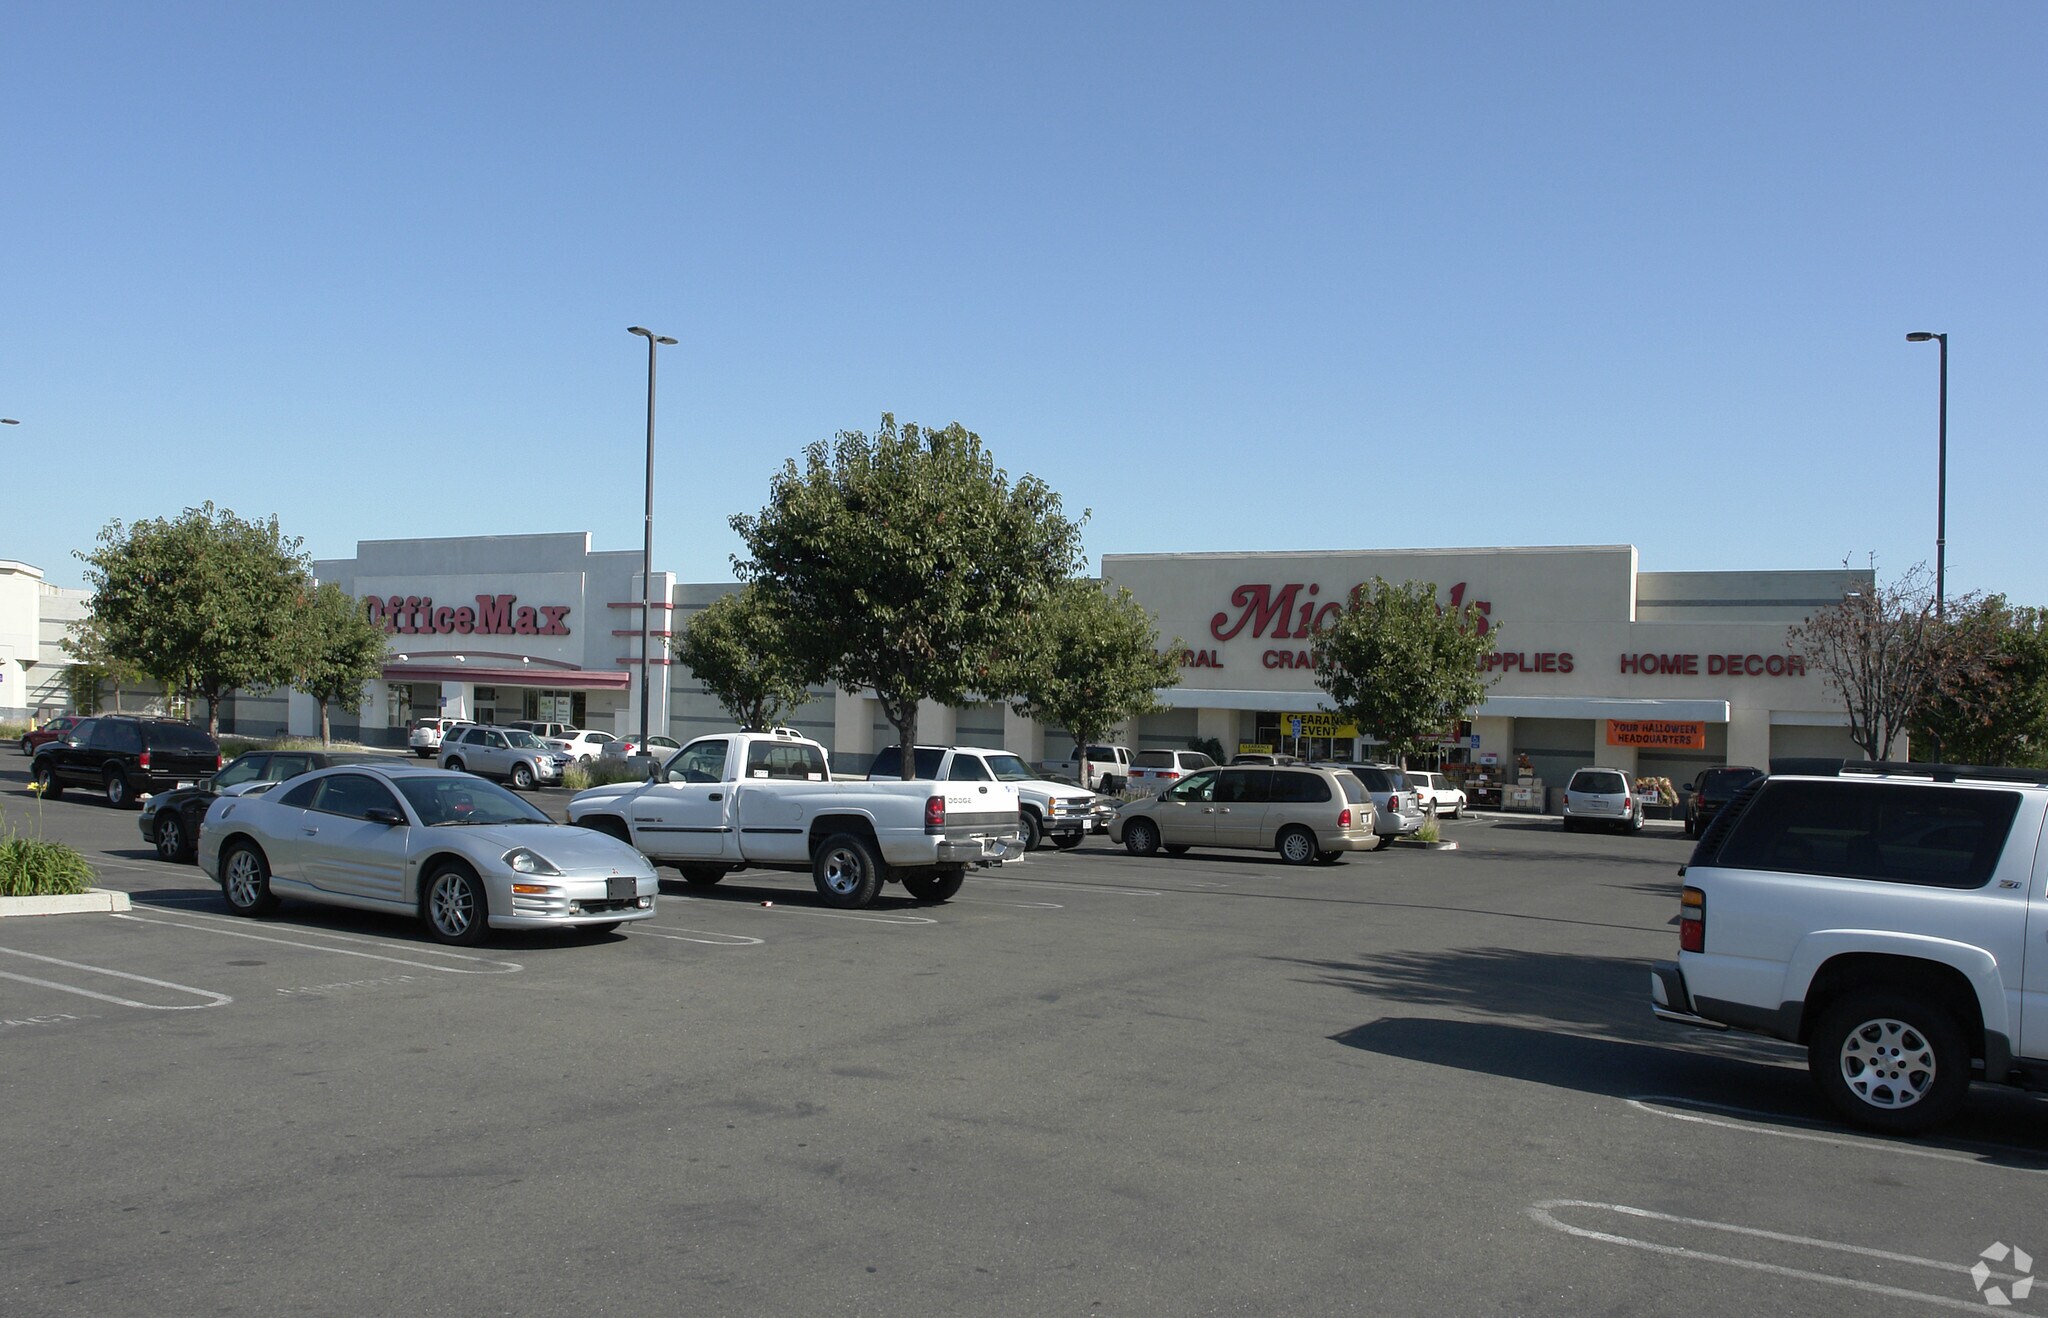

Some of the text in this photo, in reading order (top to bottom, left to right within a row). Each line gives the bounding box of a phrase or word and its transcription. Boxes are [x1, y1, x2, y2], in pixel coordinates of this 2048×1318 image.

[367, 594, 570, 635] OfficeMax
[1620, 653, 1699, 675] HOME
[1707, 654, 1806, 677] DECOR
[1301, 725, 1338, 736] EVENT
[1613, 723, 1697, 734] YOUR HALLOWEEN
[1618, 734, 1692, 745] HEADQUARTERS
